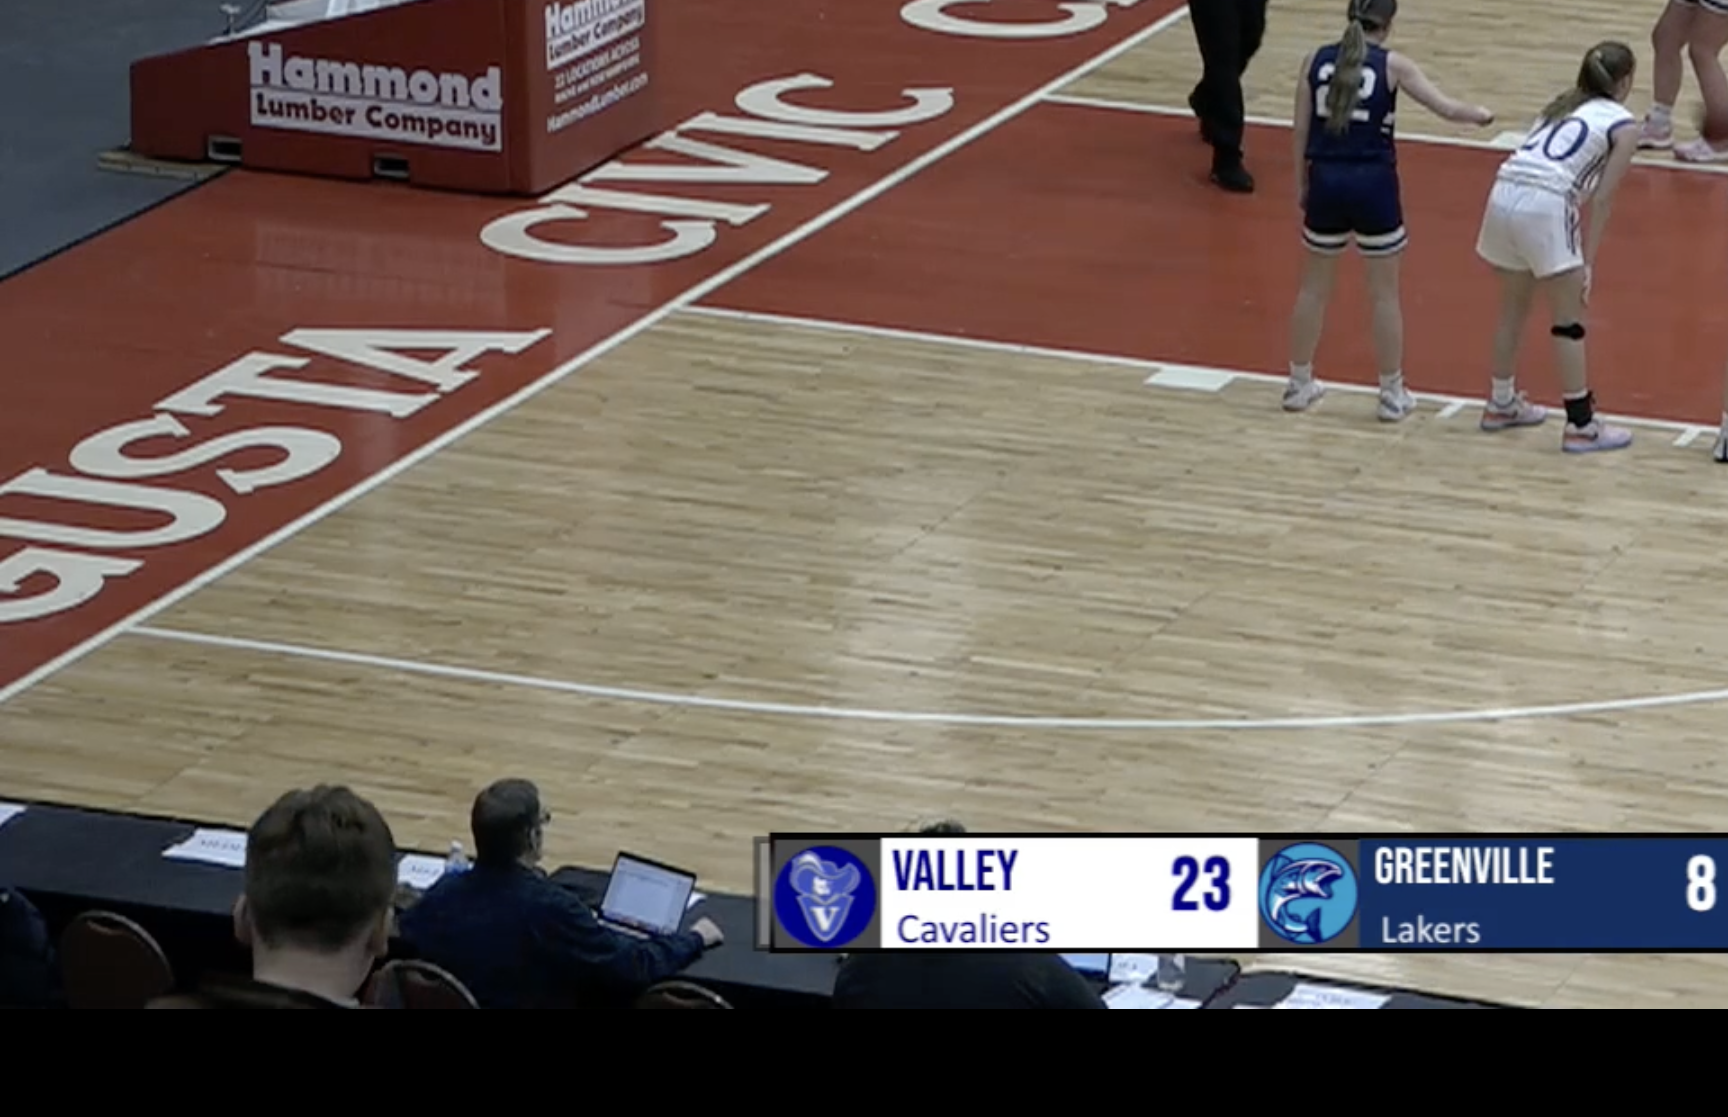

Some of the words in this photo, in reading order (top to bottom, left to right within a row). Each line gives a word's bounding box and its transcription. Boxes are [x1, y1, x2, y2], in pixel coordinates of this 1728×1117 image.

[550, 32, 590, 60] Lumber
[593, 7, 643, 40] Company
[248, 41, 503, 111] Hammond
[256, 92, 355, 125] Lumber
[365, 105, 497, 145] Company
[480, 73, 955, 265] CIVIC
